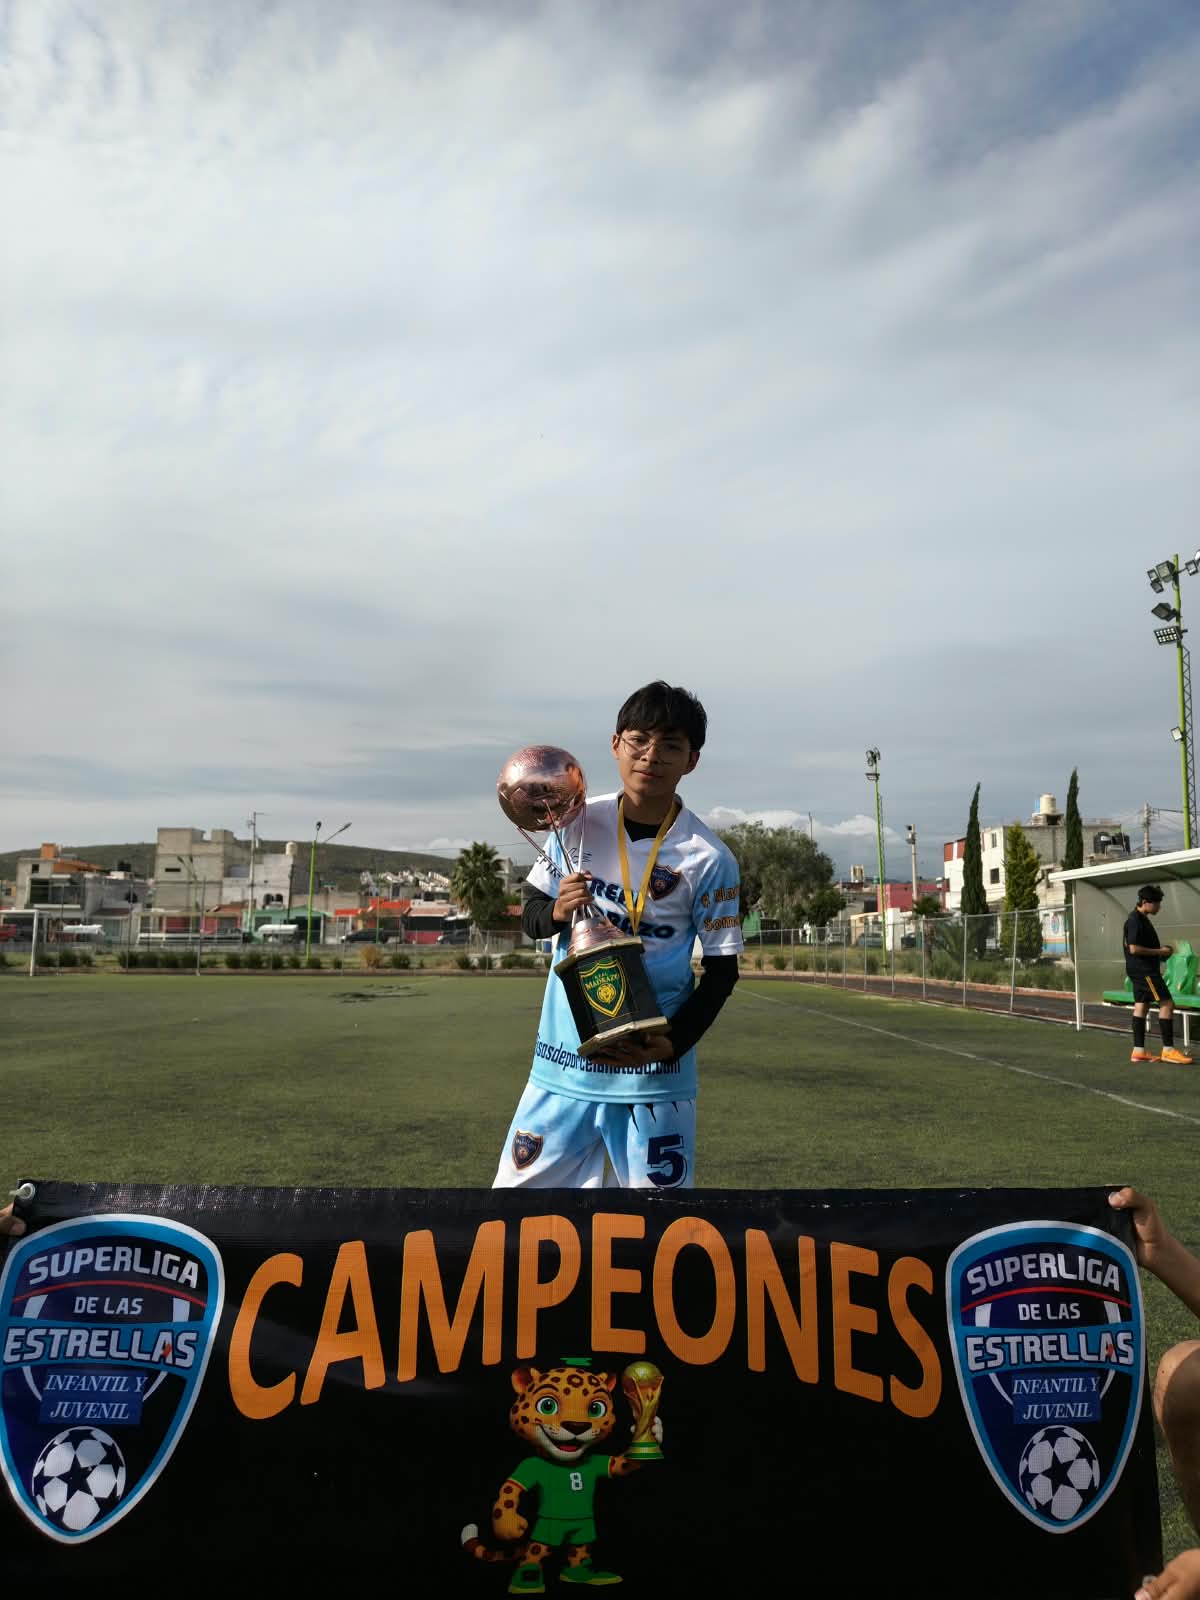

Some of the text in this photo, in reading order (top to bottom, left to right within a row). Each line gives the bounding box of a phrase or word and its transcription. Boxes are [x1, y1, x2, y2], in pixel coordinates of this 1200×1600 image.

[589, 878, 640, 906] REA
[647, 1133, 688, 1188] 5
[28, 1245, 200, 1289] SUPERLIGA
[966, 1252, 1121, 1296] SUPERLIGA
[73, 1296, 144, 1316] DE LAS
[228, 1212, 943, 1419] CAMPEONES
[1018, 1302, 1081, 1321] DE LAS
[3, 1327, 198, 1368] ESTRELLAS
[966, 1331, 1135, 1372] ESTRELLAS
[43, 1374, 149, 1393] INFANTIL Y
[1012, 1376, 1101, 1395] INFANTIL Y
[49, 1401, 130, 1420] JUVENIL
[1022, 1402, 1093, 1420] JUVENIL
[569, 1471, 583, 1491] 8
